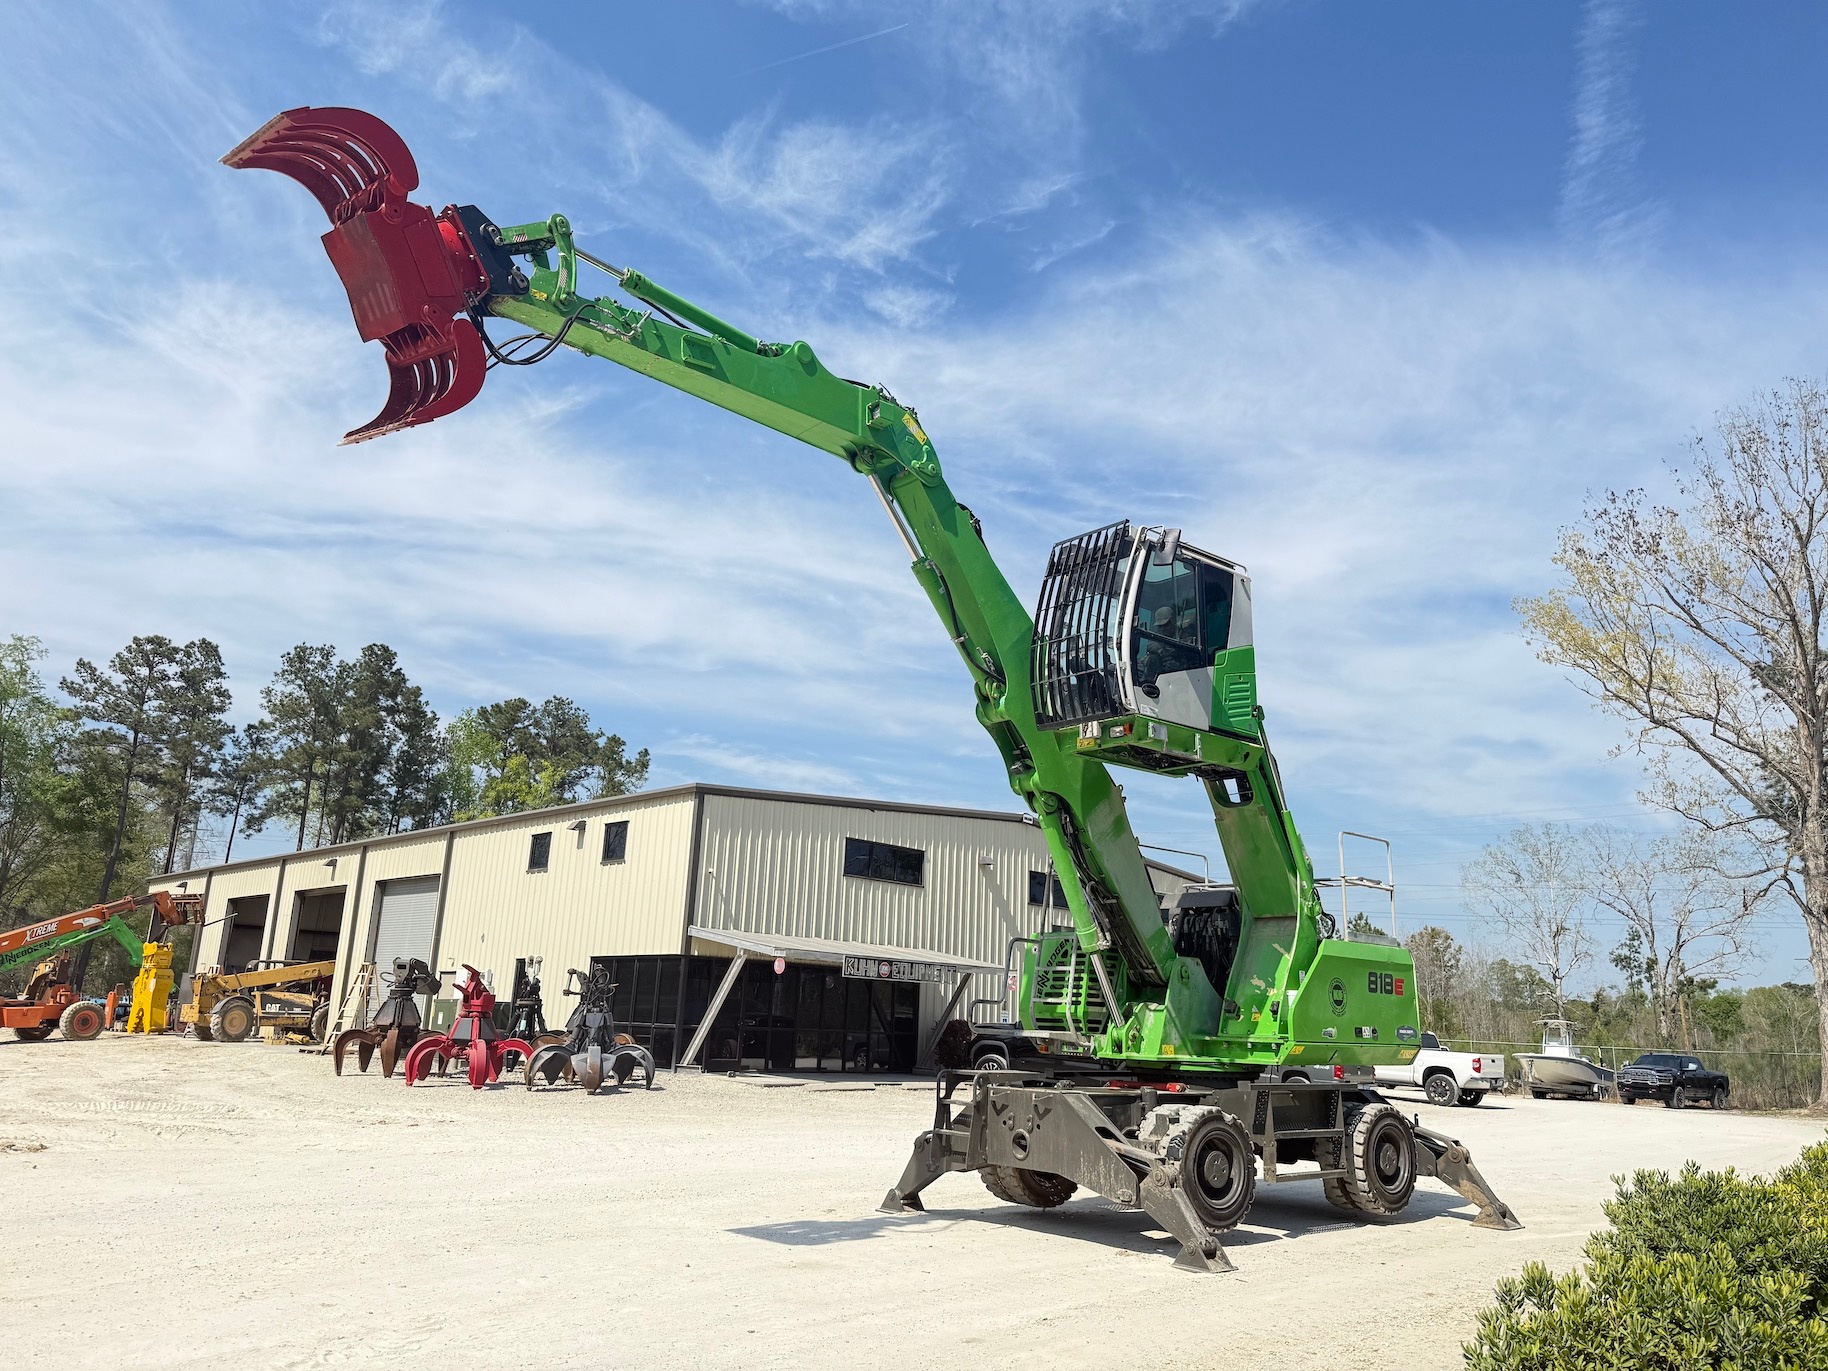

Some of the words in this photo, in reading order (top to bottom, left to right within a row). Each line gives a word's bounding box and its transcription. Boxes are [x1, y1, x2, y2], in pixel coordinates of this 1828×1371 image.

[21, 921, 59, 946] XTREME
[844, 957, 879, 978] KUHN
[891, 961, 957, 983] EQUIPMENT
[265, 1003, 281, 1013] CAT
